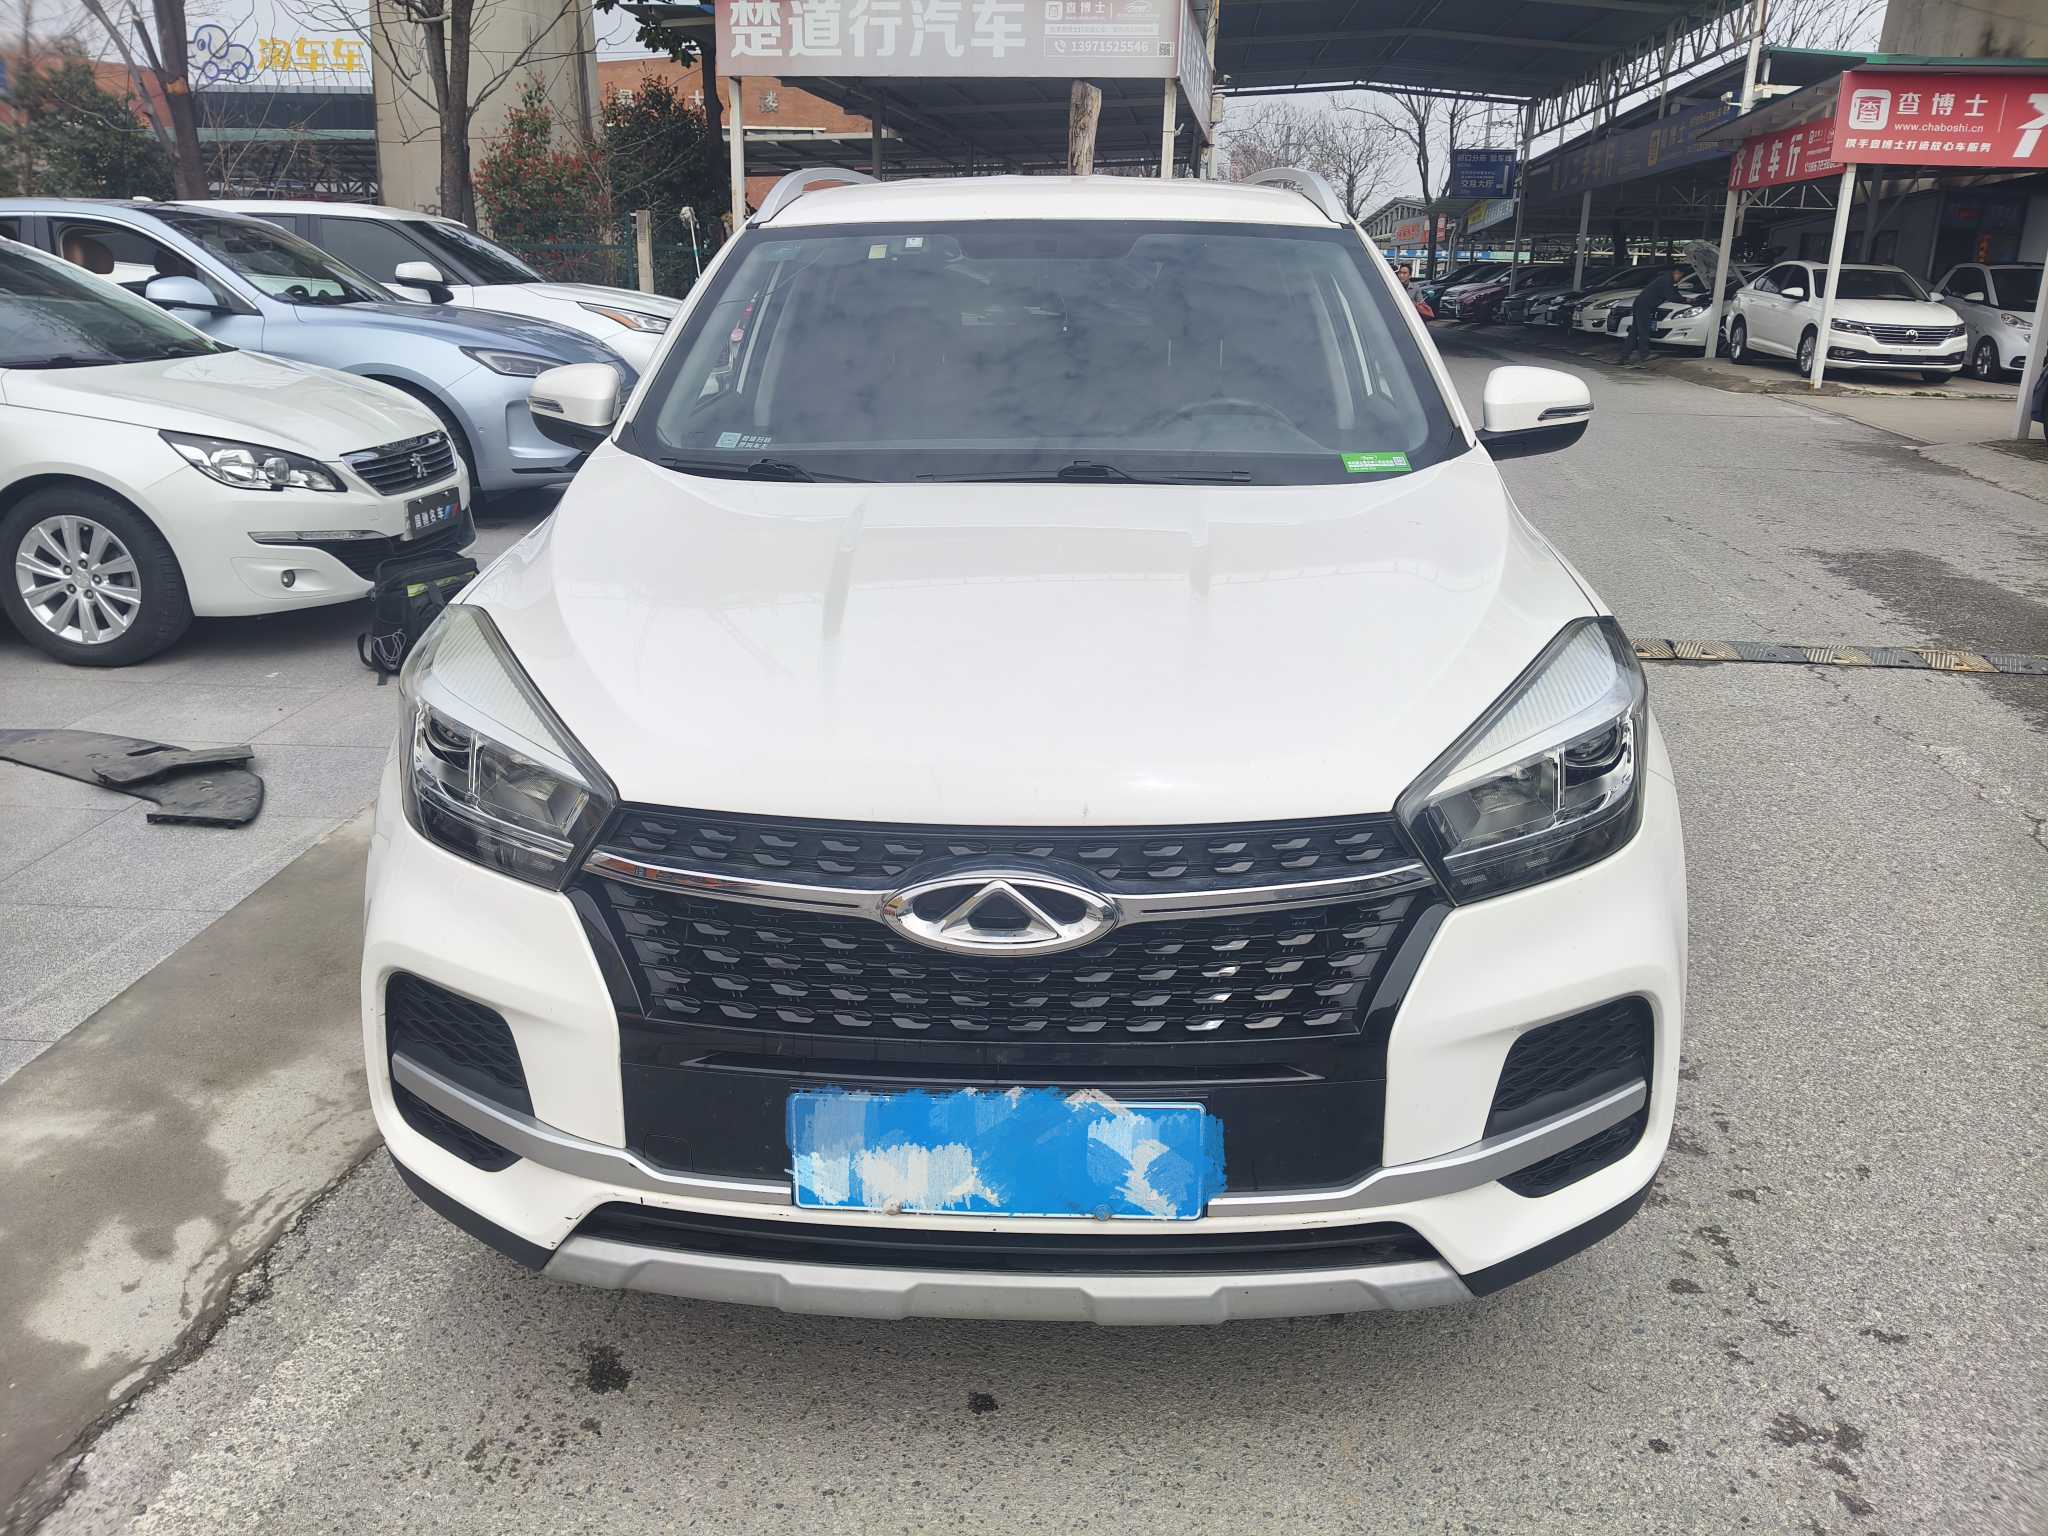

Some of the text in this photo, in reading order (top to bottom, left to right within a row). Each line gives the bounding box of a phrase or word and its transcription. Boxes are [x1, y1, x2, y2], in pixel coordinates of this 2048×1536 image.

[729, 0, 1026, 57] 楚道行汽车
[1897, 92, 1989, 118] 查博士
[1894, 122, 1984, 133] www.chaboshi.cn
